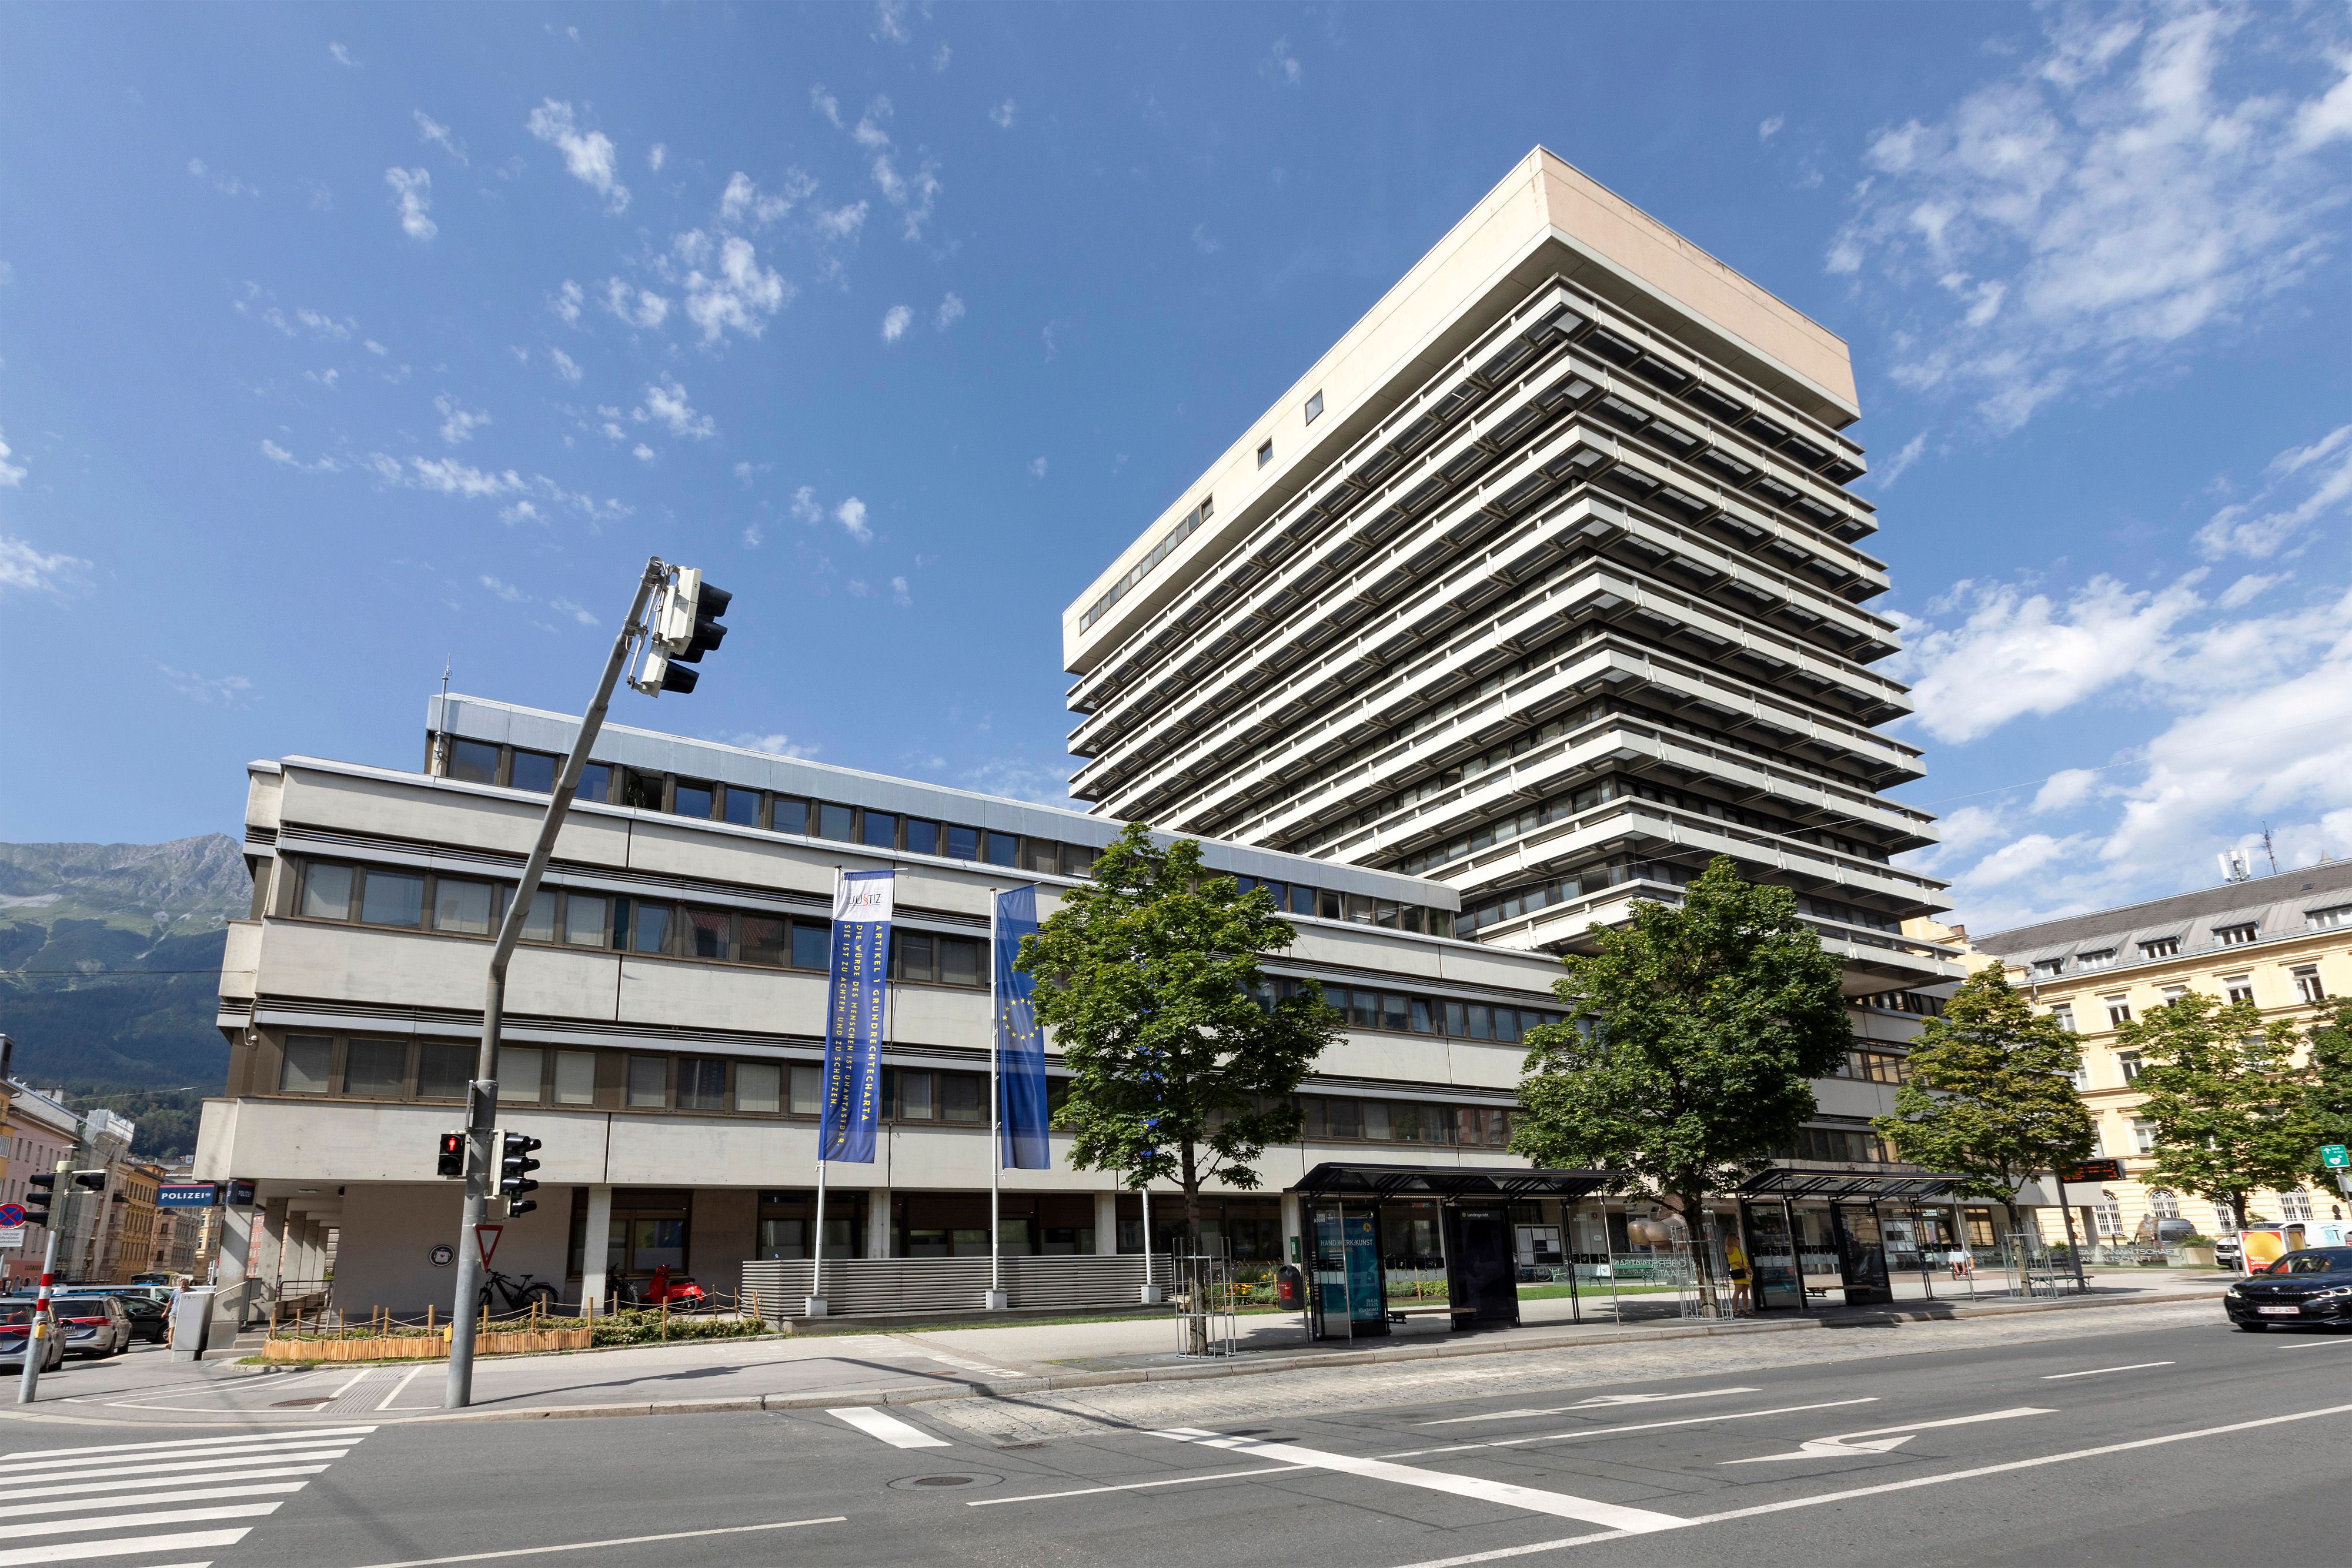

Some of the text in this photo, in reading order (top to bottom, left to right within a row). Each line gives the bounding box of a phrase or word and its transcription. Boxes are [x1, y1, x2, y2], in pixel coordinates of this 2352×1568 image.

[841, 961, 848, 972] ZU
[853, 945, 863, 976] WÜRDE
[874, 925, 883, 972] ARTIKEL
[838, 977, 847, 1012] ACHTEN
[835, 1041, 841, 1052] ZU
[847, 1002, 857, 1051] MENSCHEN
[861, 989, 880, 1121] GRUNDRECHTECHARTA
[830, 1057, 841, 1107] SCHÜTZEN.
[837, 1075, 851, 1146] UNANTASTBAR.
